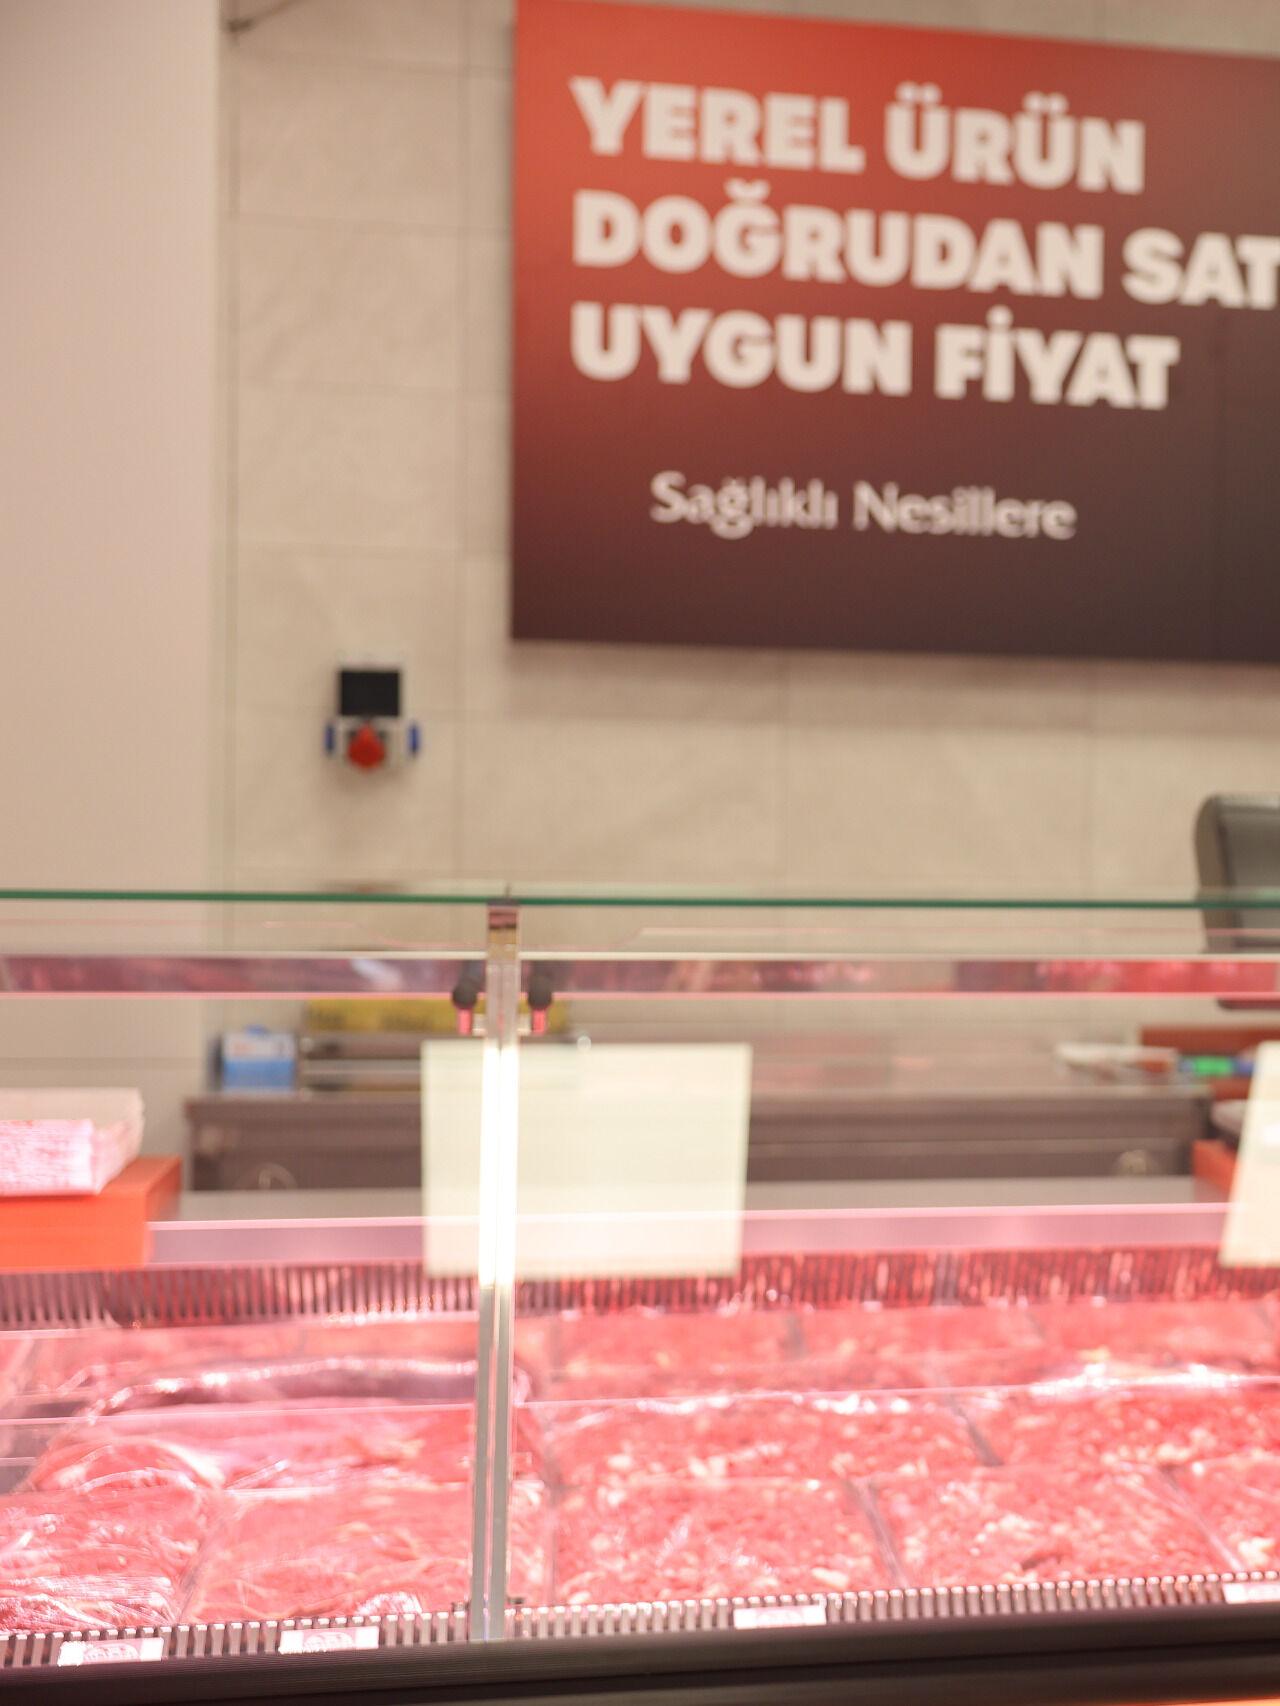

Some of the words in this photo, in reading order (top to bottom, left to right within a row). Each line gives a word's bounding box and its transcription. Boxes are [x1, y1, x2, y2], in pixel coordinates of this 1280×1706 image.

[571, 77, 865, 174] YEREL
[885, 81, 1144, 193] ÜRÜN
[573, 178, 1104, 298] DOĞRUDAN
[571, 301, 912, 396] UYGUN
[935, 305, 1180, 410] FİYAT
[650, 470, 838, 539] Sağlıklı
[853, 481, 1077, 540] Nesillere
